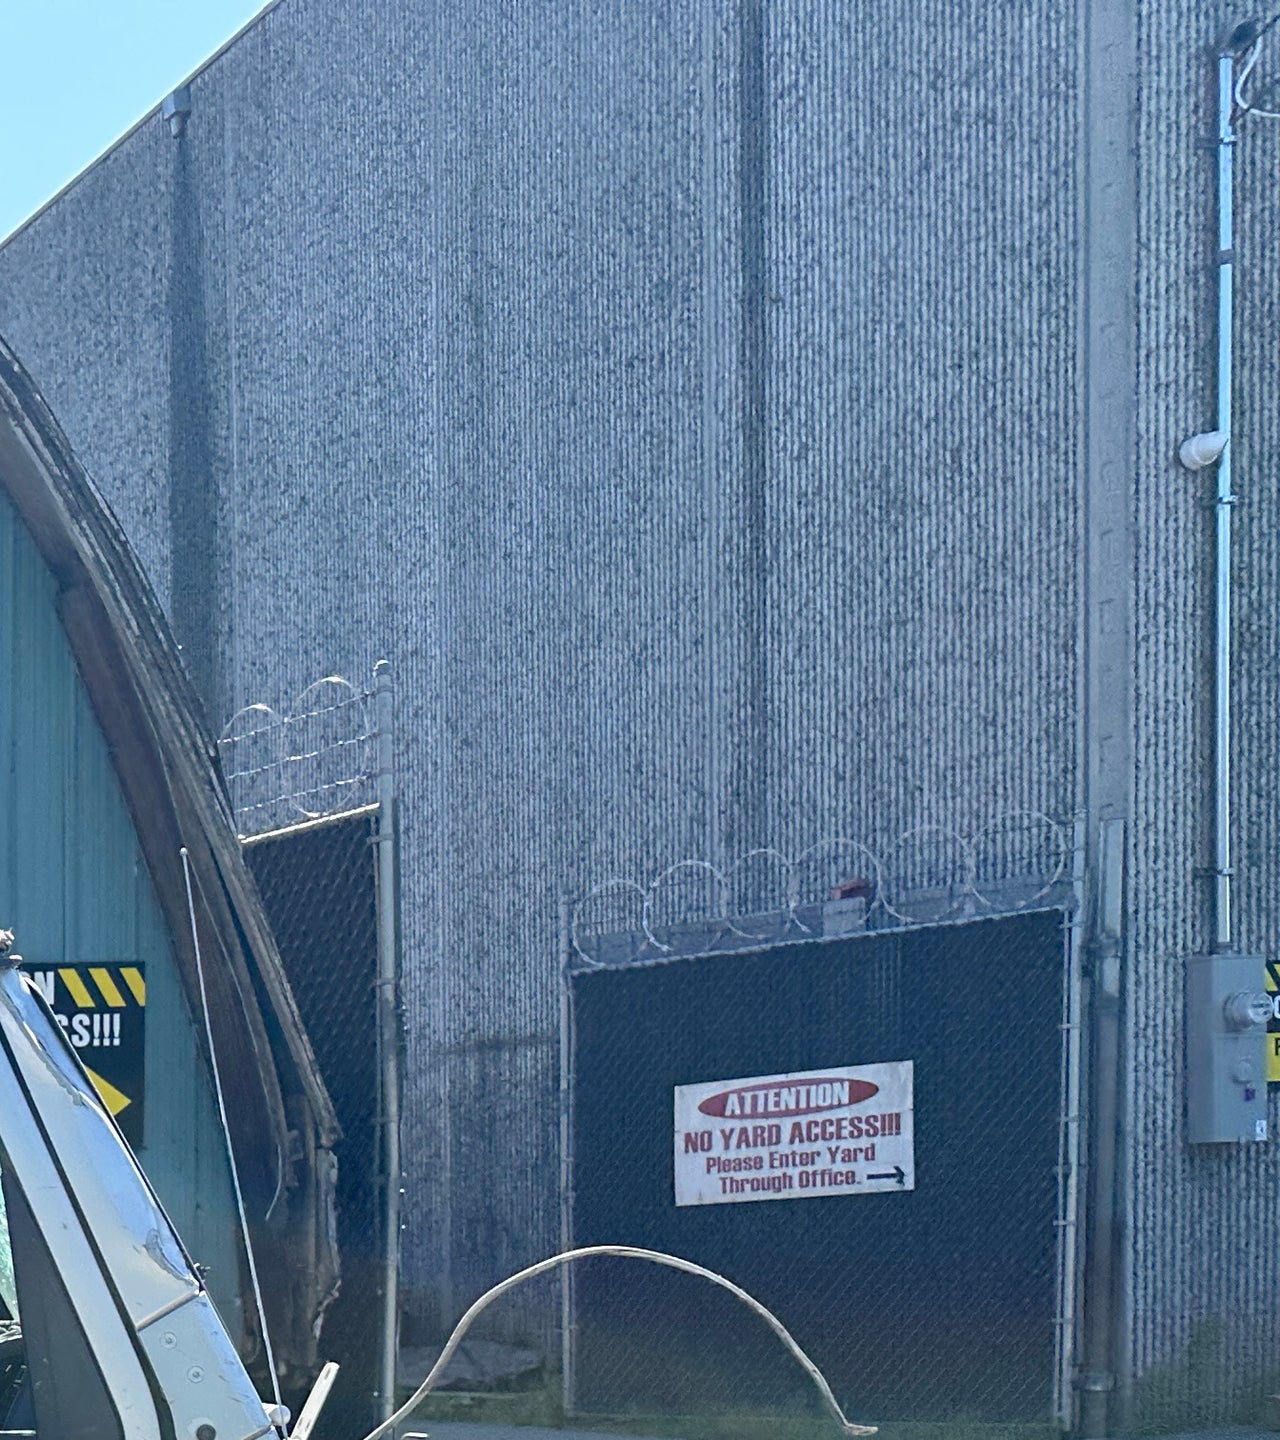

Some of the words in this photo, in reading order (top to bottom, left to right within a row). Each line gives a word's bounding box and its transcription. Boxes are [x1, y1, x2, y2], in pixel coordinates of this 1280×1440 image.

[724, 1080, 851, 1117] ATTENTION
[684, 1130, 713, 1154] NO
[720, 1123, 782, 1150] YARD
[789, 1112, 902, 1145] ACCESS!!!
[706, 1149, 764, 1174] Please
[769, 1150, 822, 1170] Enter
[827, 1143, 876, 1164] Yard
[720, 1171, 793, 1195] Through
[798, 1168, 862, 1189] Office.
